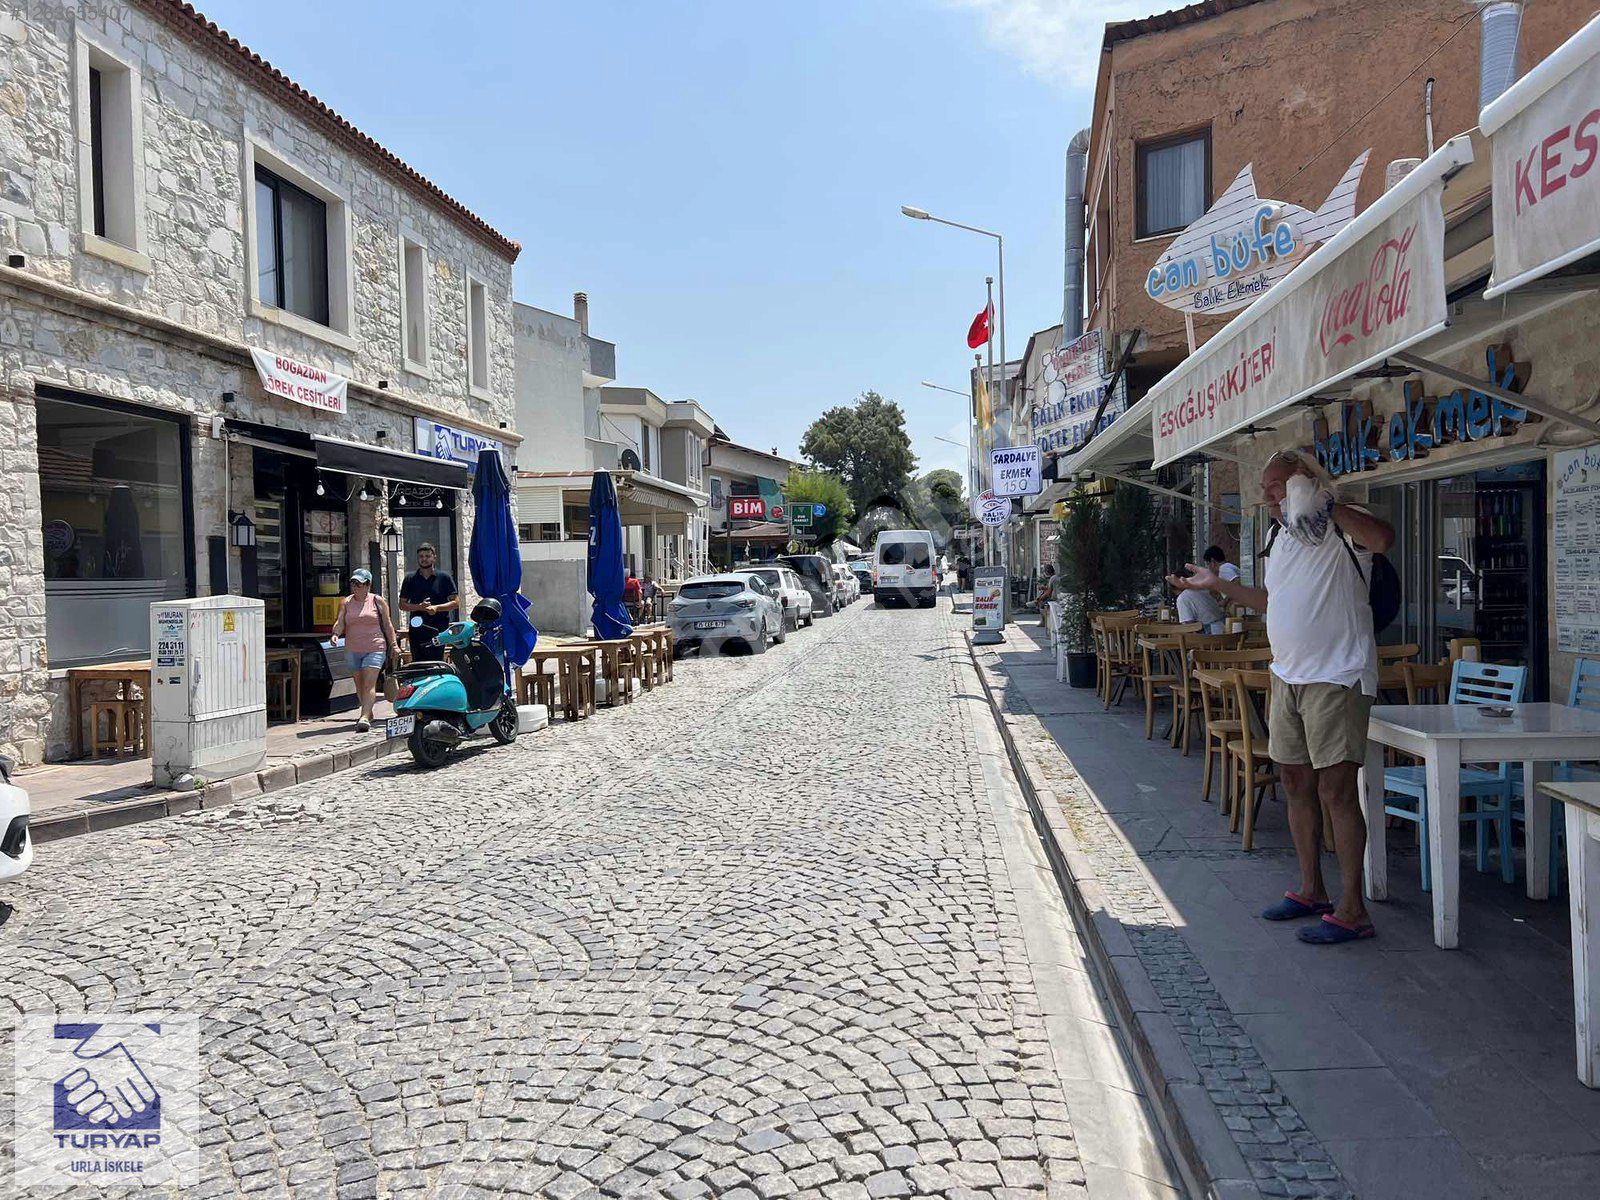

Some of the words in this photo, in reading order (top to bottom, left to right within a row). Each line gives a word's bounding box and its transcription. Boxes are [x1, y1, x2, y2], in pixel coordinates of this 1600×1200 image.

[1147, 257, 1200, 298] can
[1210, 204, 1296, 278] büfe
[264, 374, 295, 397] ÖREK
[1389, 345, 1528, 462] ekmek
[1032, 402, 1066, 429] BALIK
[993, 451, 1037, 465] SARDALYE
[1000, 467, 1032, 480] EKMEK
[733, 499, 762, 514] BİM
[389, 719, 398, 728] 35
